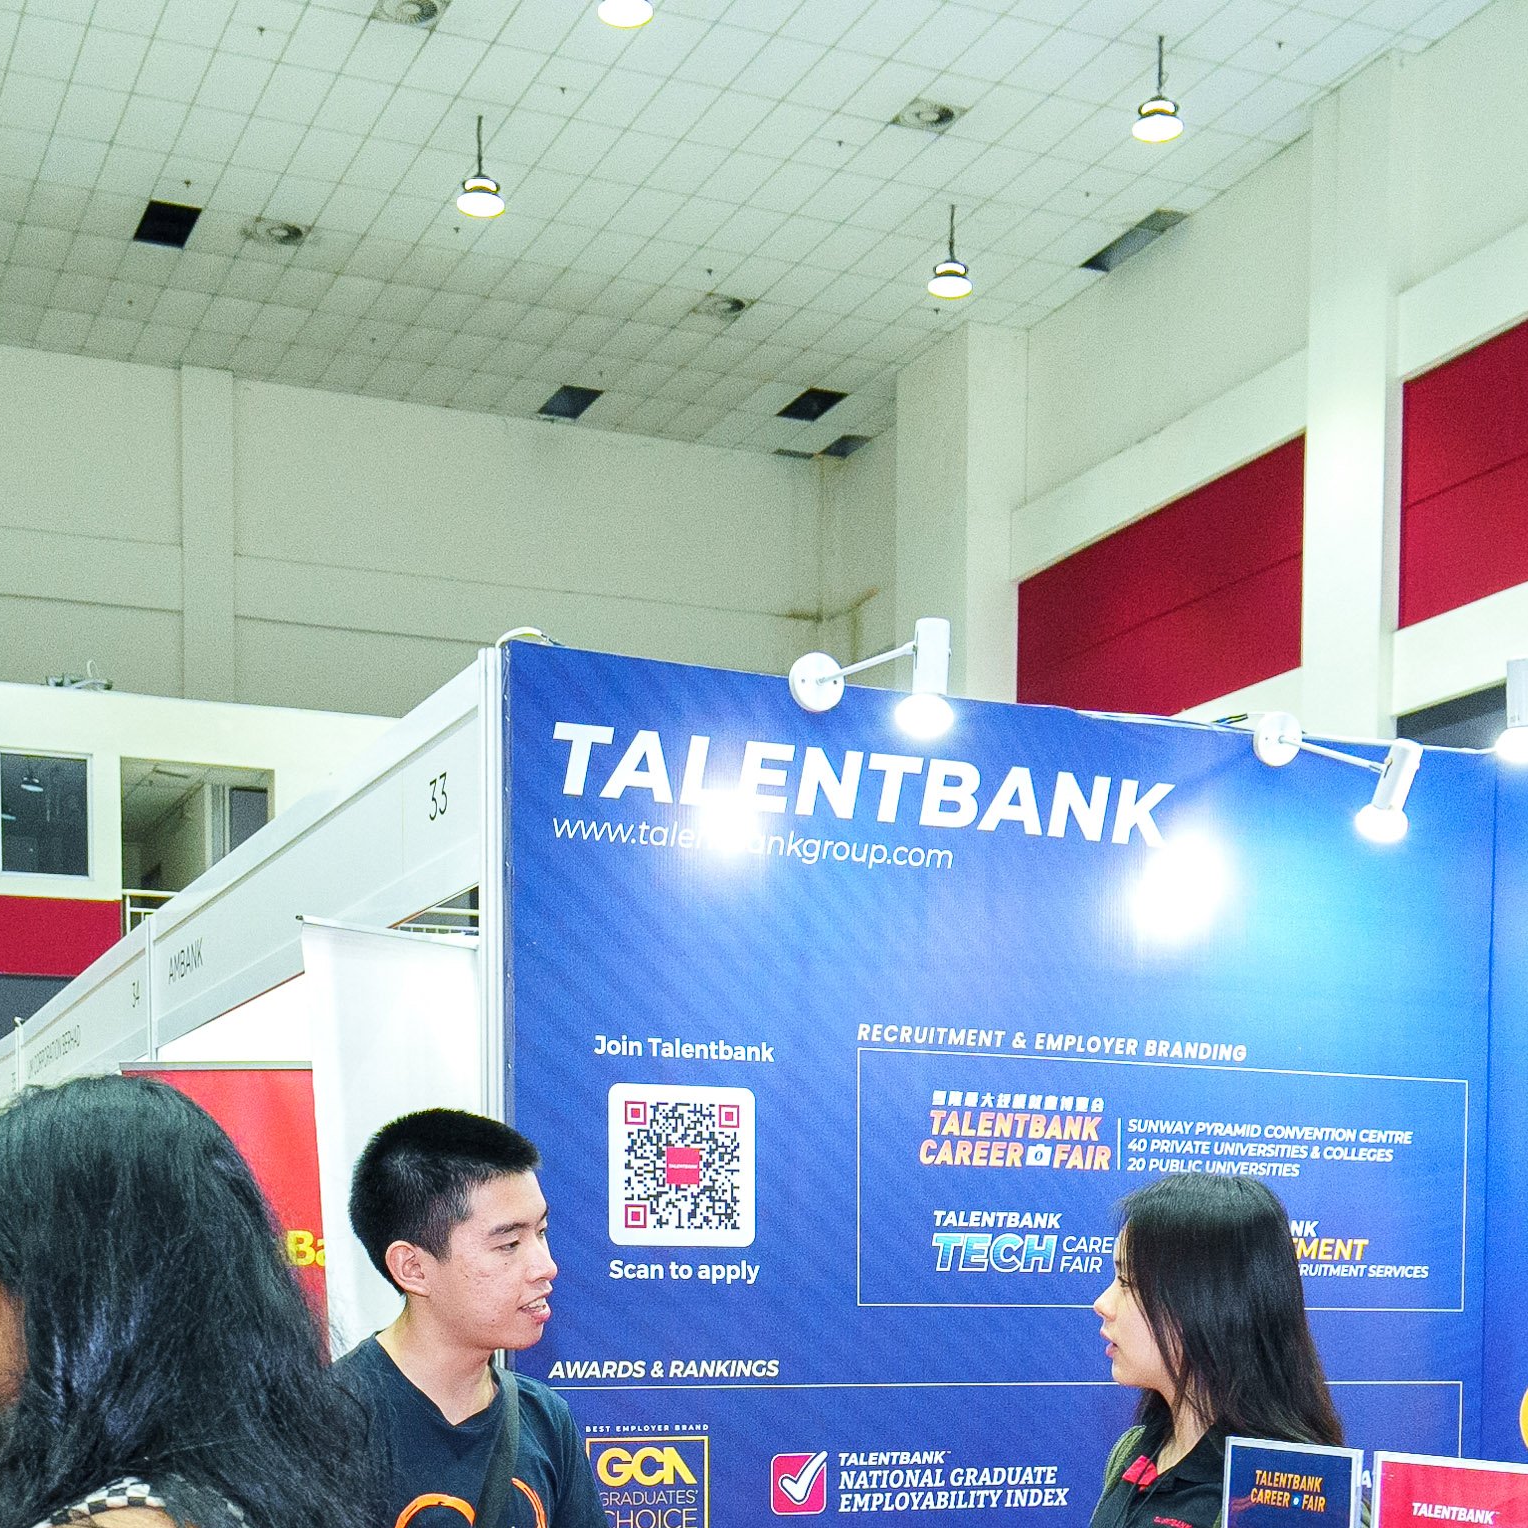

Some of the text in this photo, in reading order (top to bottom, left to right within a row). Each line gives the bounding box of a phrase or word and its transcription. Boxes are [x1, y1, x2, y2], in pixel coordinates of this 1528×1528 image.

[428, 771, 449, 822] 33
[552, 721, 1175, 849] TALENTBANK
[168, 937, 204, 985] AMBANK
[594, 1034, 775, 1064] Join Talentbank
[857, 1024, 1248, 1062] RECRUITMENT & EMPLOYER BRANDING
[929, 1109, 1102, 1142] TALENTBANK
[1127, 1118, 1413, 1145] SUNWAY PYRAMID CONVENTION CENTRE
[919, 1138, 1112, 1171] CAREER FAIR
[1127, 1138, 1394, 1163] 40 PRIVATE UNIVERSITIES & COLLEGES
[1127, 1157, 1301, 1177] 20 PUBLIC UNIVERSITIES
[933, 1210, 1063, 1229] TALENTBANK
[932, 1232, 1114, 1273] TECH CARE
[1060, 1256, 1102, 1273] FAIR
[609, 1259, 760, 1286] Scan to apply
[1299, 1264, 1429, 1279] RUITMENT SERVICES
[549, 1360, 780, 1379] AWARDS & RANKINGS
[585, 1425, 610, 1433] BEST
[616, 1424, 670, 1432] EMPLOYER
[596, 1446, 698, 1487] GCA
[838, 1466, 1058, 1491] NATIONAL GRADUATE
[1255, 1469, 1323, 1493] TALENTBANK
[838, 1487, 1070, 1514] EMPLOYABILITY INDEX
[1250, 1487, 1326, 1512] CAREER FAIR
